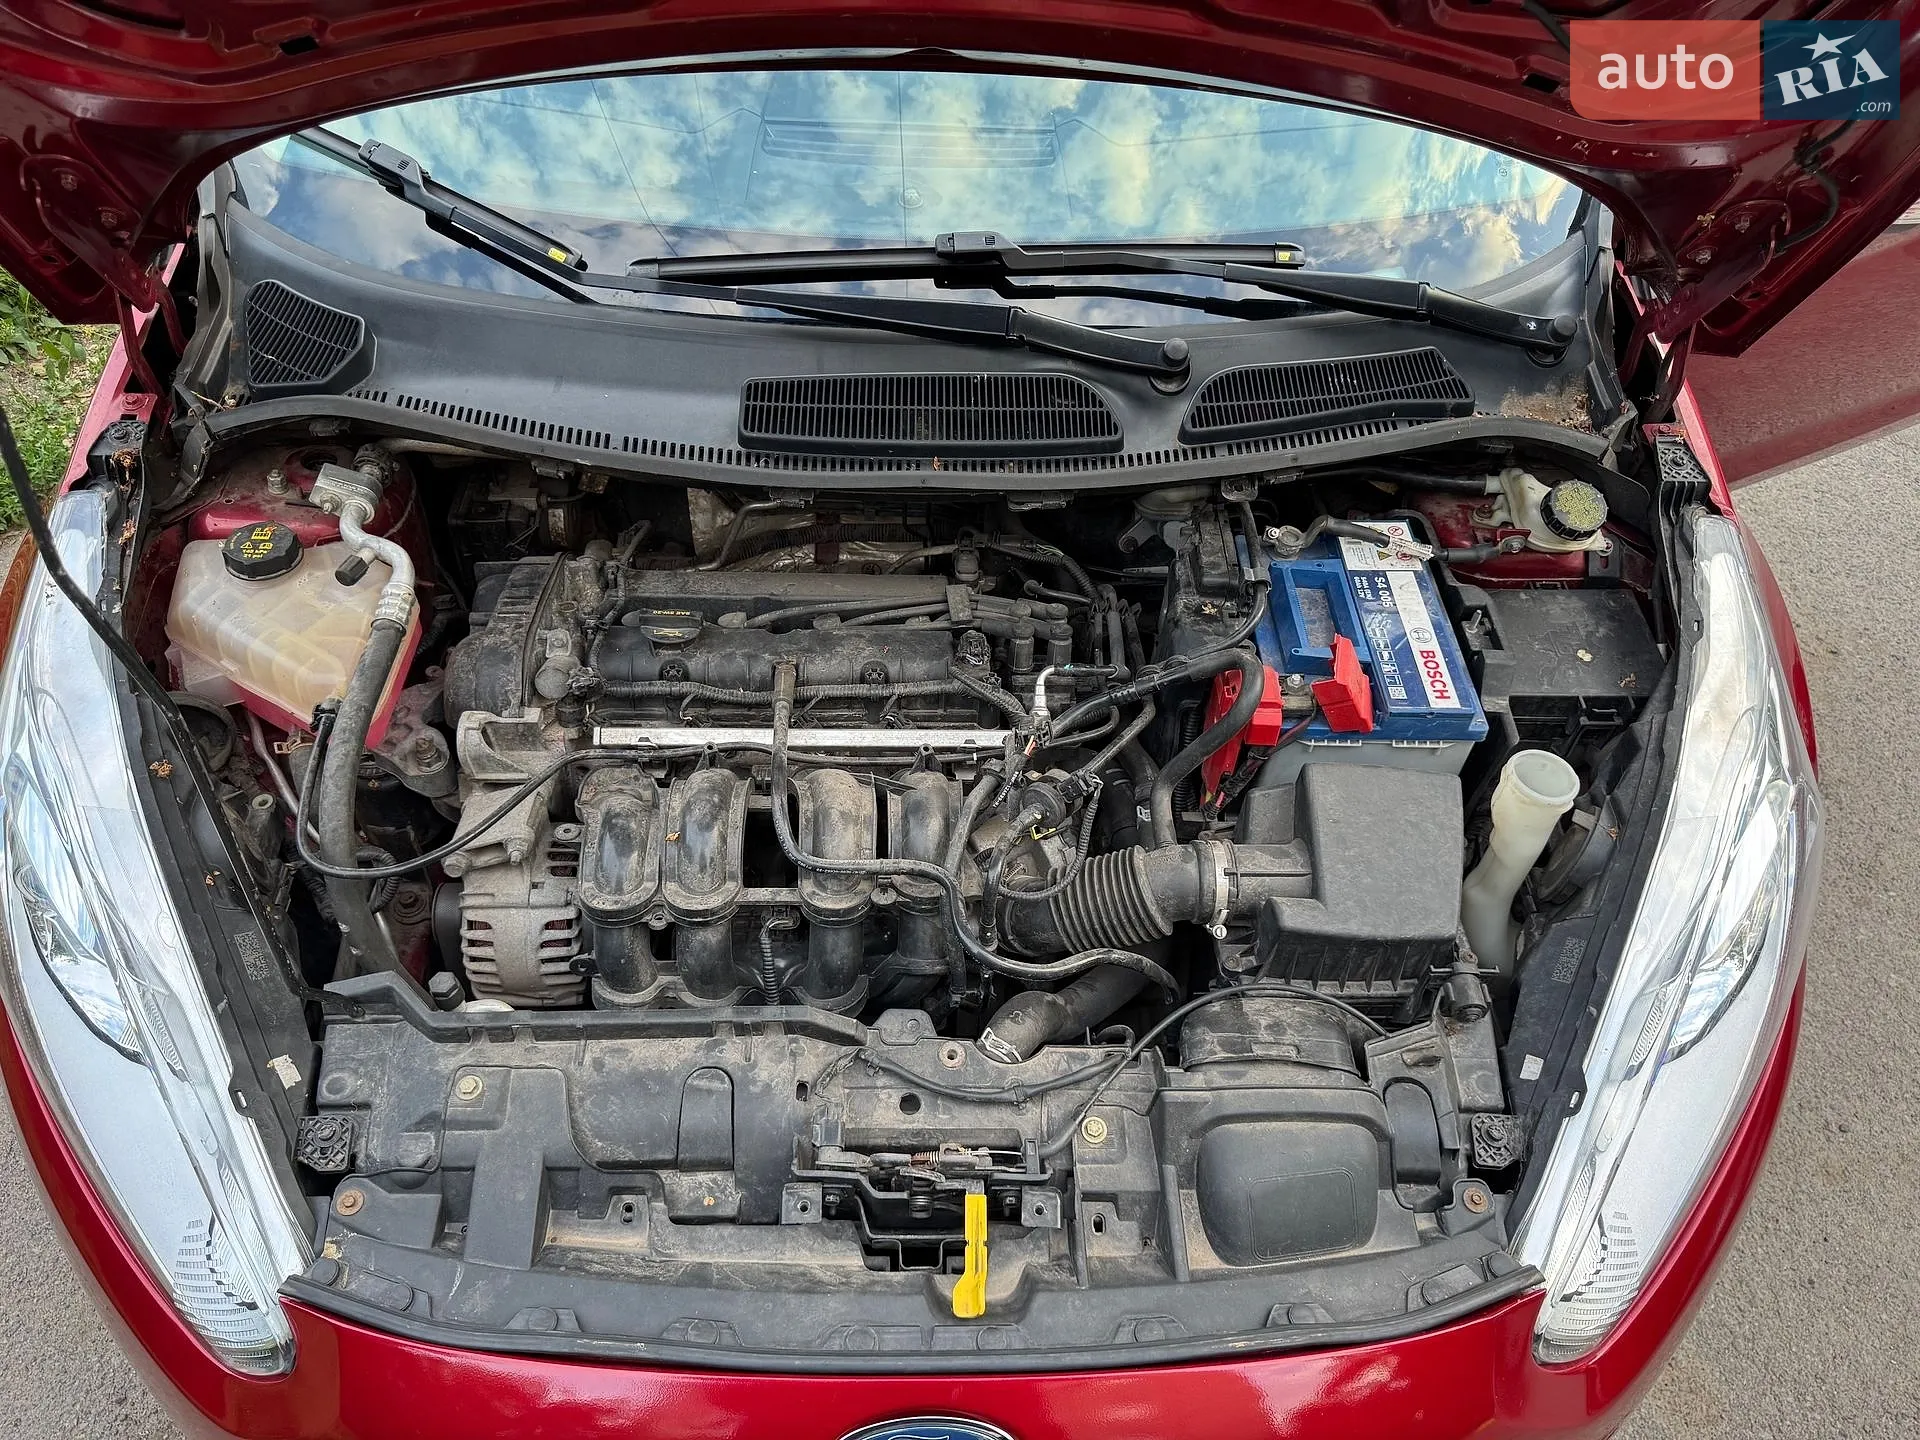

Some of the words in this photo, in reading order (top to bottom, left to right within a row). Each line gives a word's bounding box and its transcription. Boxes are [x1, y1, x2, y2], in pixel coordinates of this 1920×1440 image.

[1374, 576, 1388, 589] S4
[1378, 590, 1394, 608] 005
[1419, 649, 1451, 701] BOSCH
